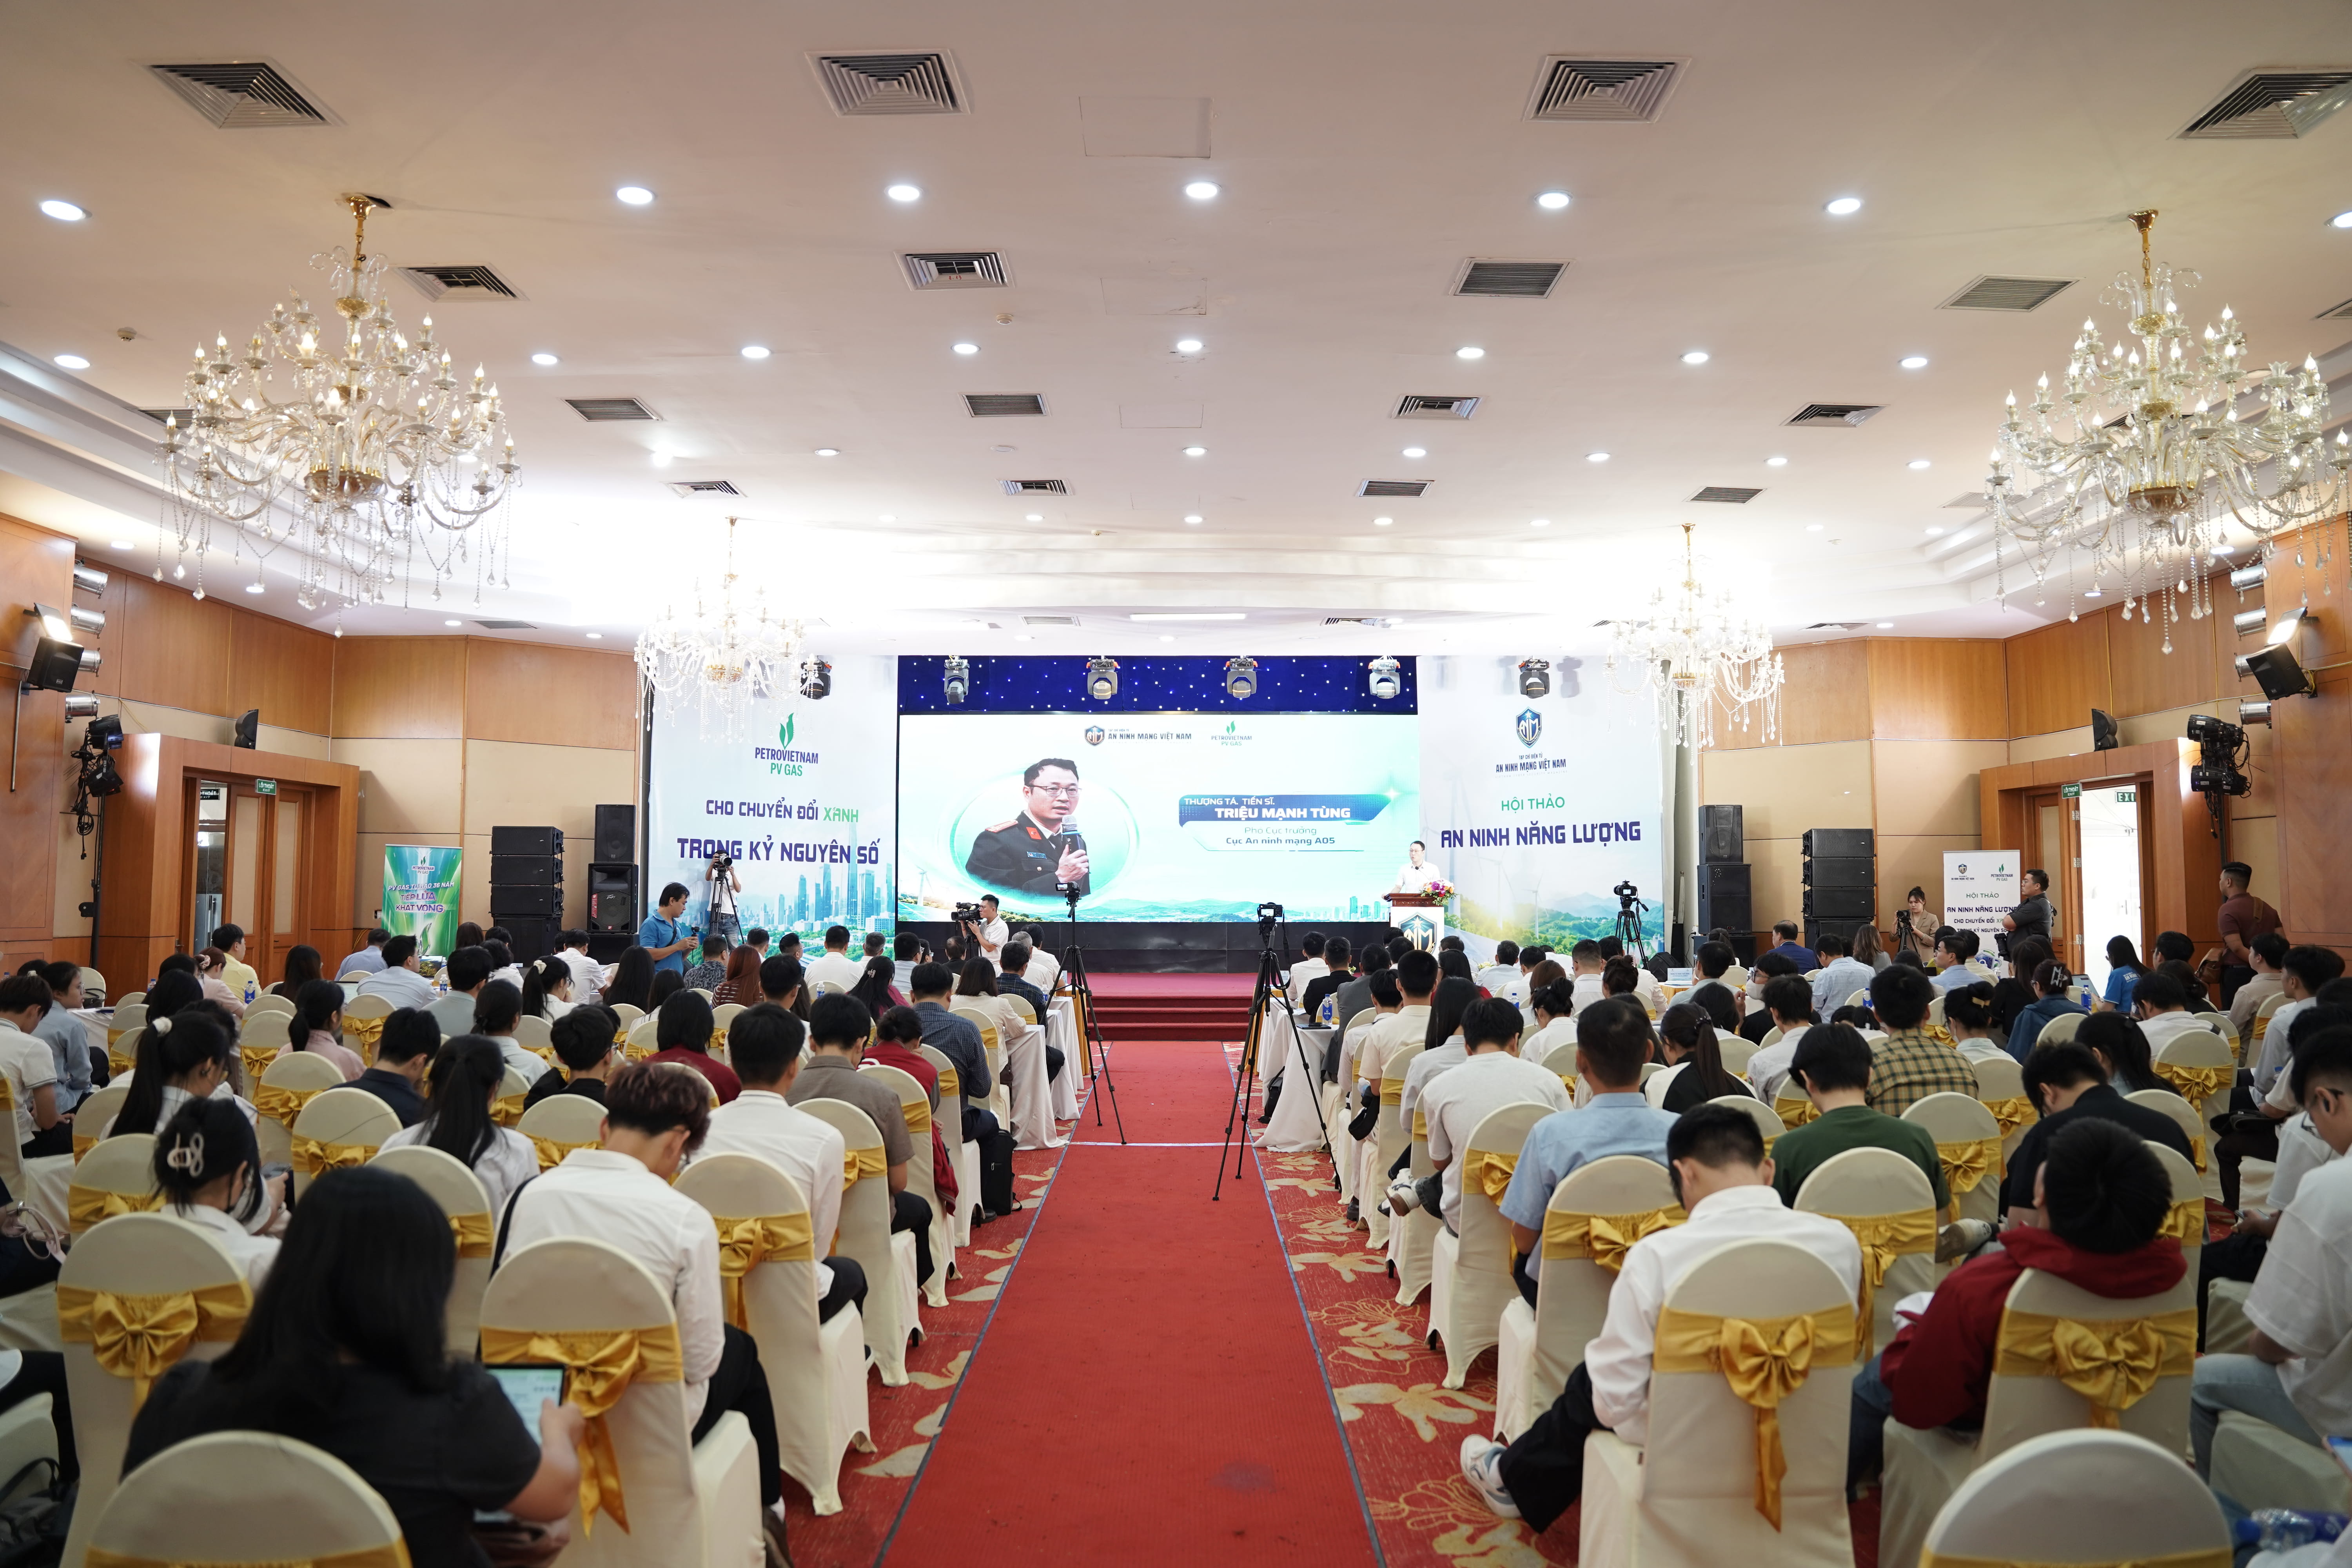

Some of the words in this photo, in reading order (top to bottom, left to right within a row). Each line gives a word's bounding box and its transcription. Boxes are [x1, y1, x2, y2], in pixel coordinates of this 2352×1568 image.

[1160, 732, 1173, 741] VIỆT
[755, 747, 818, 764] PETROVIETNAM
[771, 762, 782, 774] PV
[784, 764, 802, 776] GAS
[1496, 764, 1503, 773] AN
[1505, 763, 1518, 772] NINH
[1520, 761, 1537, 772] MẠNG
[1539, 758, 1550, 771] VIỆT
[1552, 759, 1566, 768] NAM
[1184, 797, 1223, 806] THƯỢNG
[1242, 796, 1262, 805] TIẾN
[1502, 797, 1524, 813] HỘI
[1528, 793, 1565, 809] THẢO
[2118, 793, 2135, 802] EXI
[706, 800, 733, 815] CHO
[739, 797, 792, 818] CHUYỂN
[797, 799, 818, 820] ĐỔI
[823, 807, 858, 822] XANH
[1214, 806, 1258, 820] TRIỆU
[1262, 808, 1307, 820] MẠNH
[1310, 806, 1350, 818] TÙNG
[1286, 826, 1316, 835] trưởng
[1441, 829, 1463, 848] AN
[1470, 828, 1509, 847] NINH
[1516, 820, 1566, 846] NĂNG
[1573, 821, 1641, 847] LƯỢNG
[1226, 837, 1242, 846] Cục
[677, 838, 742, 860] TRONG
[750, 835, 774, 860] KỶ
[780, 839, 850, 864] NGUYÊN
[857, 838, 880, 864] SỐ
[401, 892, 415, 901] TIẾP
[417, 890, 436, 901] LỬA
[417, 904, 445, 914] VỌNG
